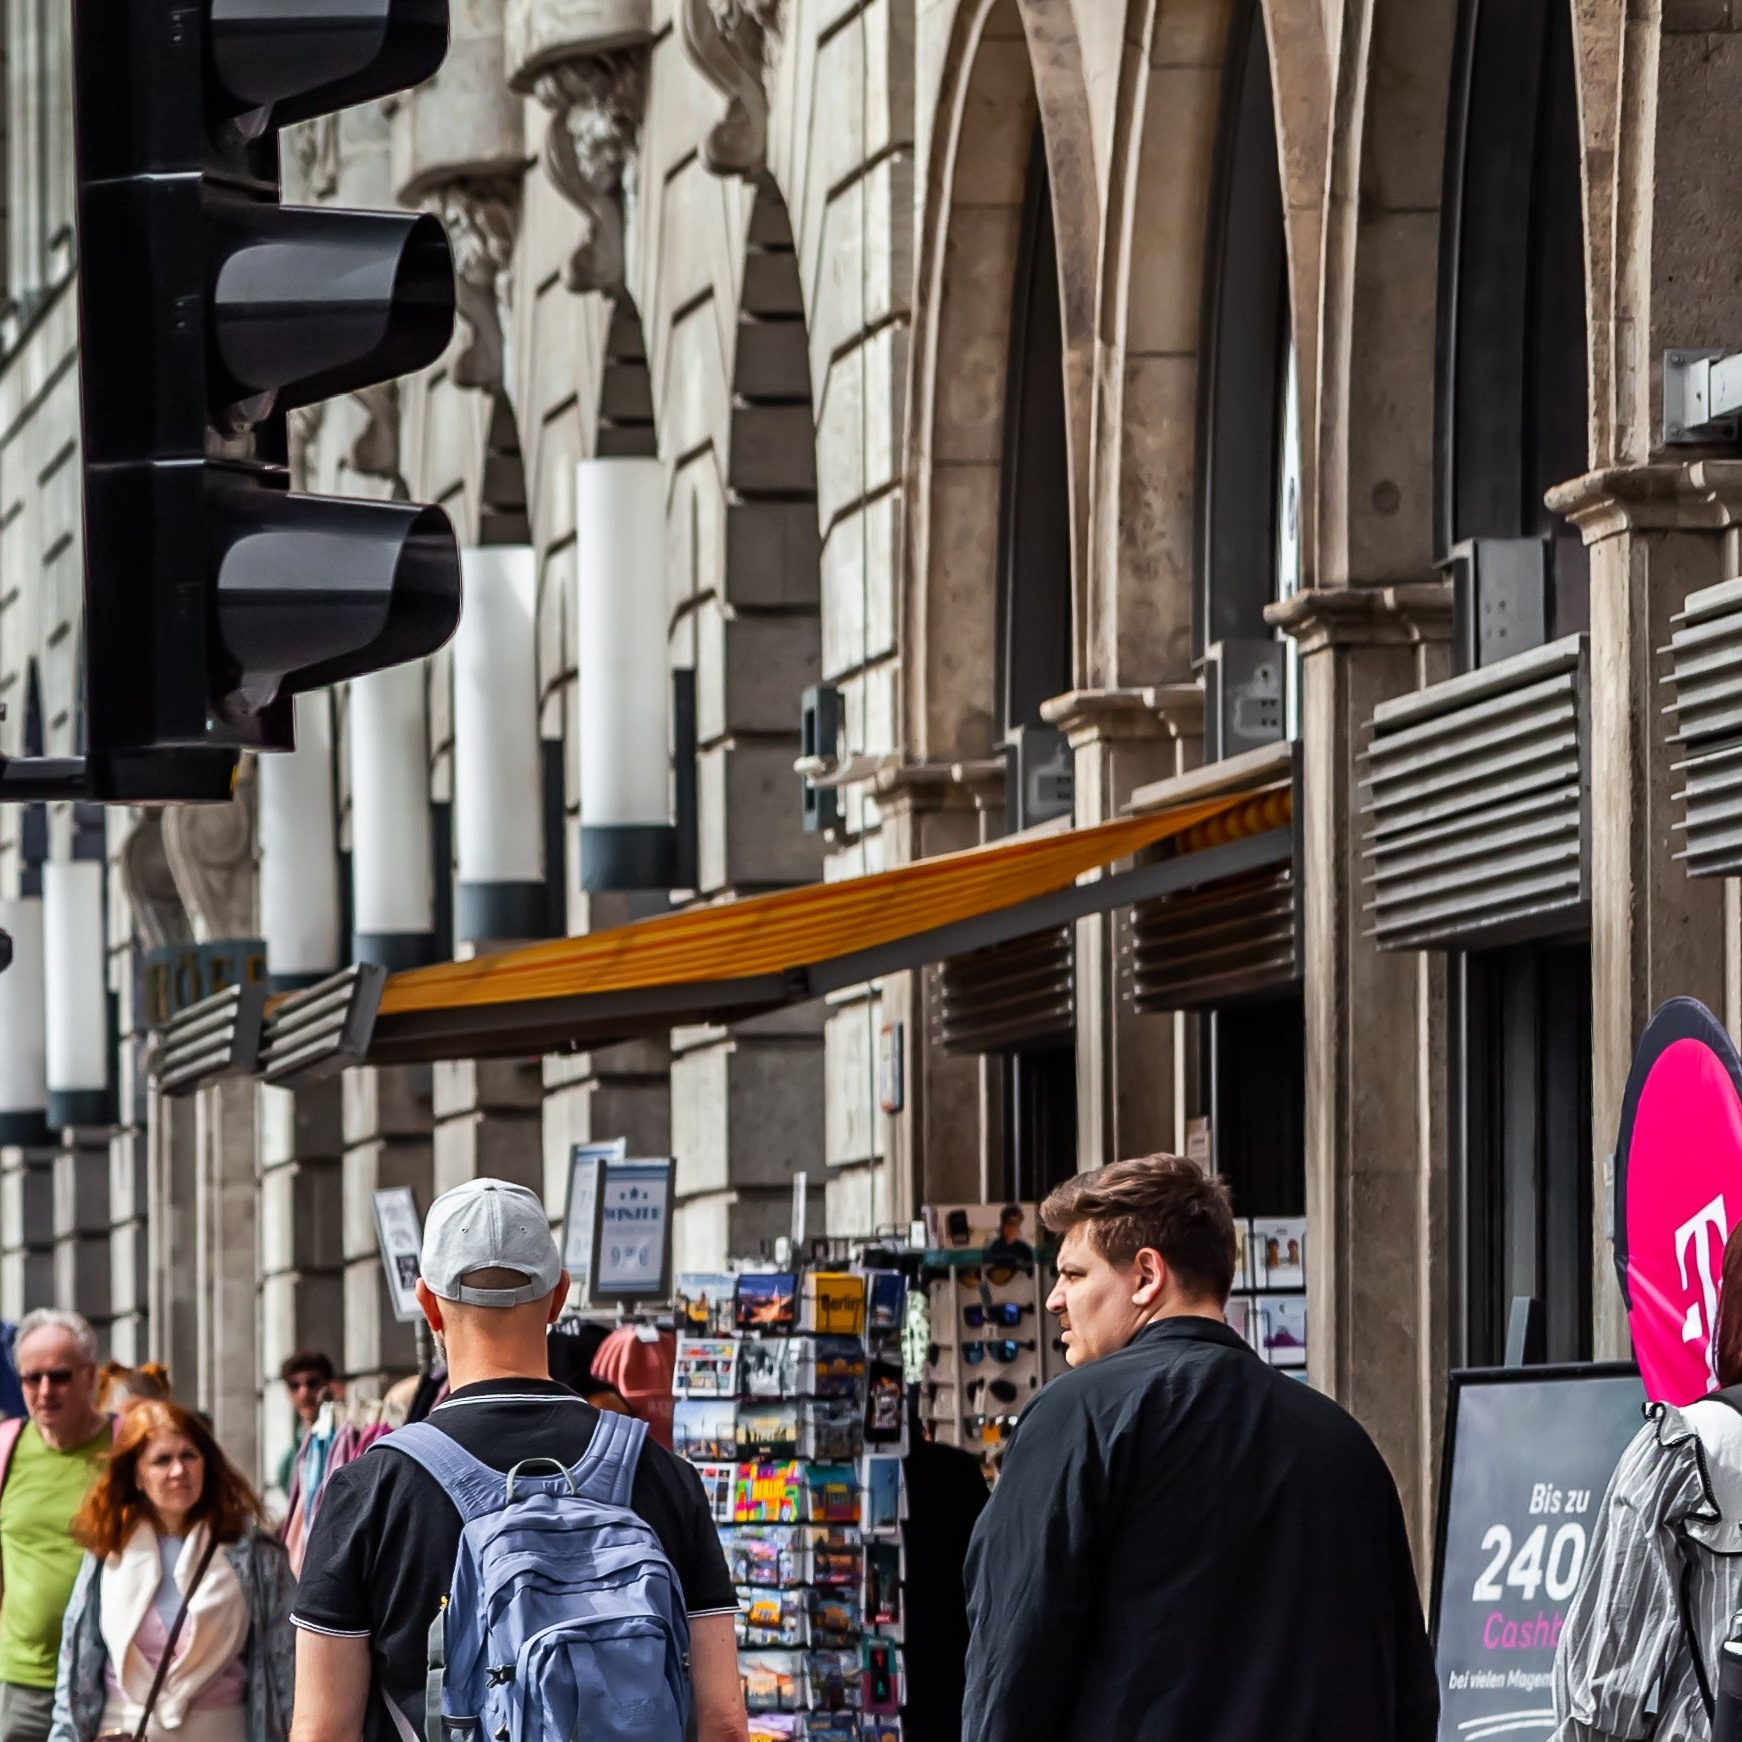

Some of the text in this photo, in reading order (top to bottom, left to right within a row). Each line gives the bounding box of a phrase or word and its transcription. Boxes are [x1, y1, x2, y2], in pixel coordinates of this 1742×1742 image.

[1529, 1483, 1591, 1515] Bis zu
[1472, 1522, 1586, 1602] 240
[1448, 1670, 1469, 1690] bei
[1470, 1670, 1505, 1689] vielen
